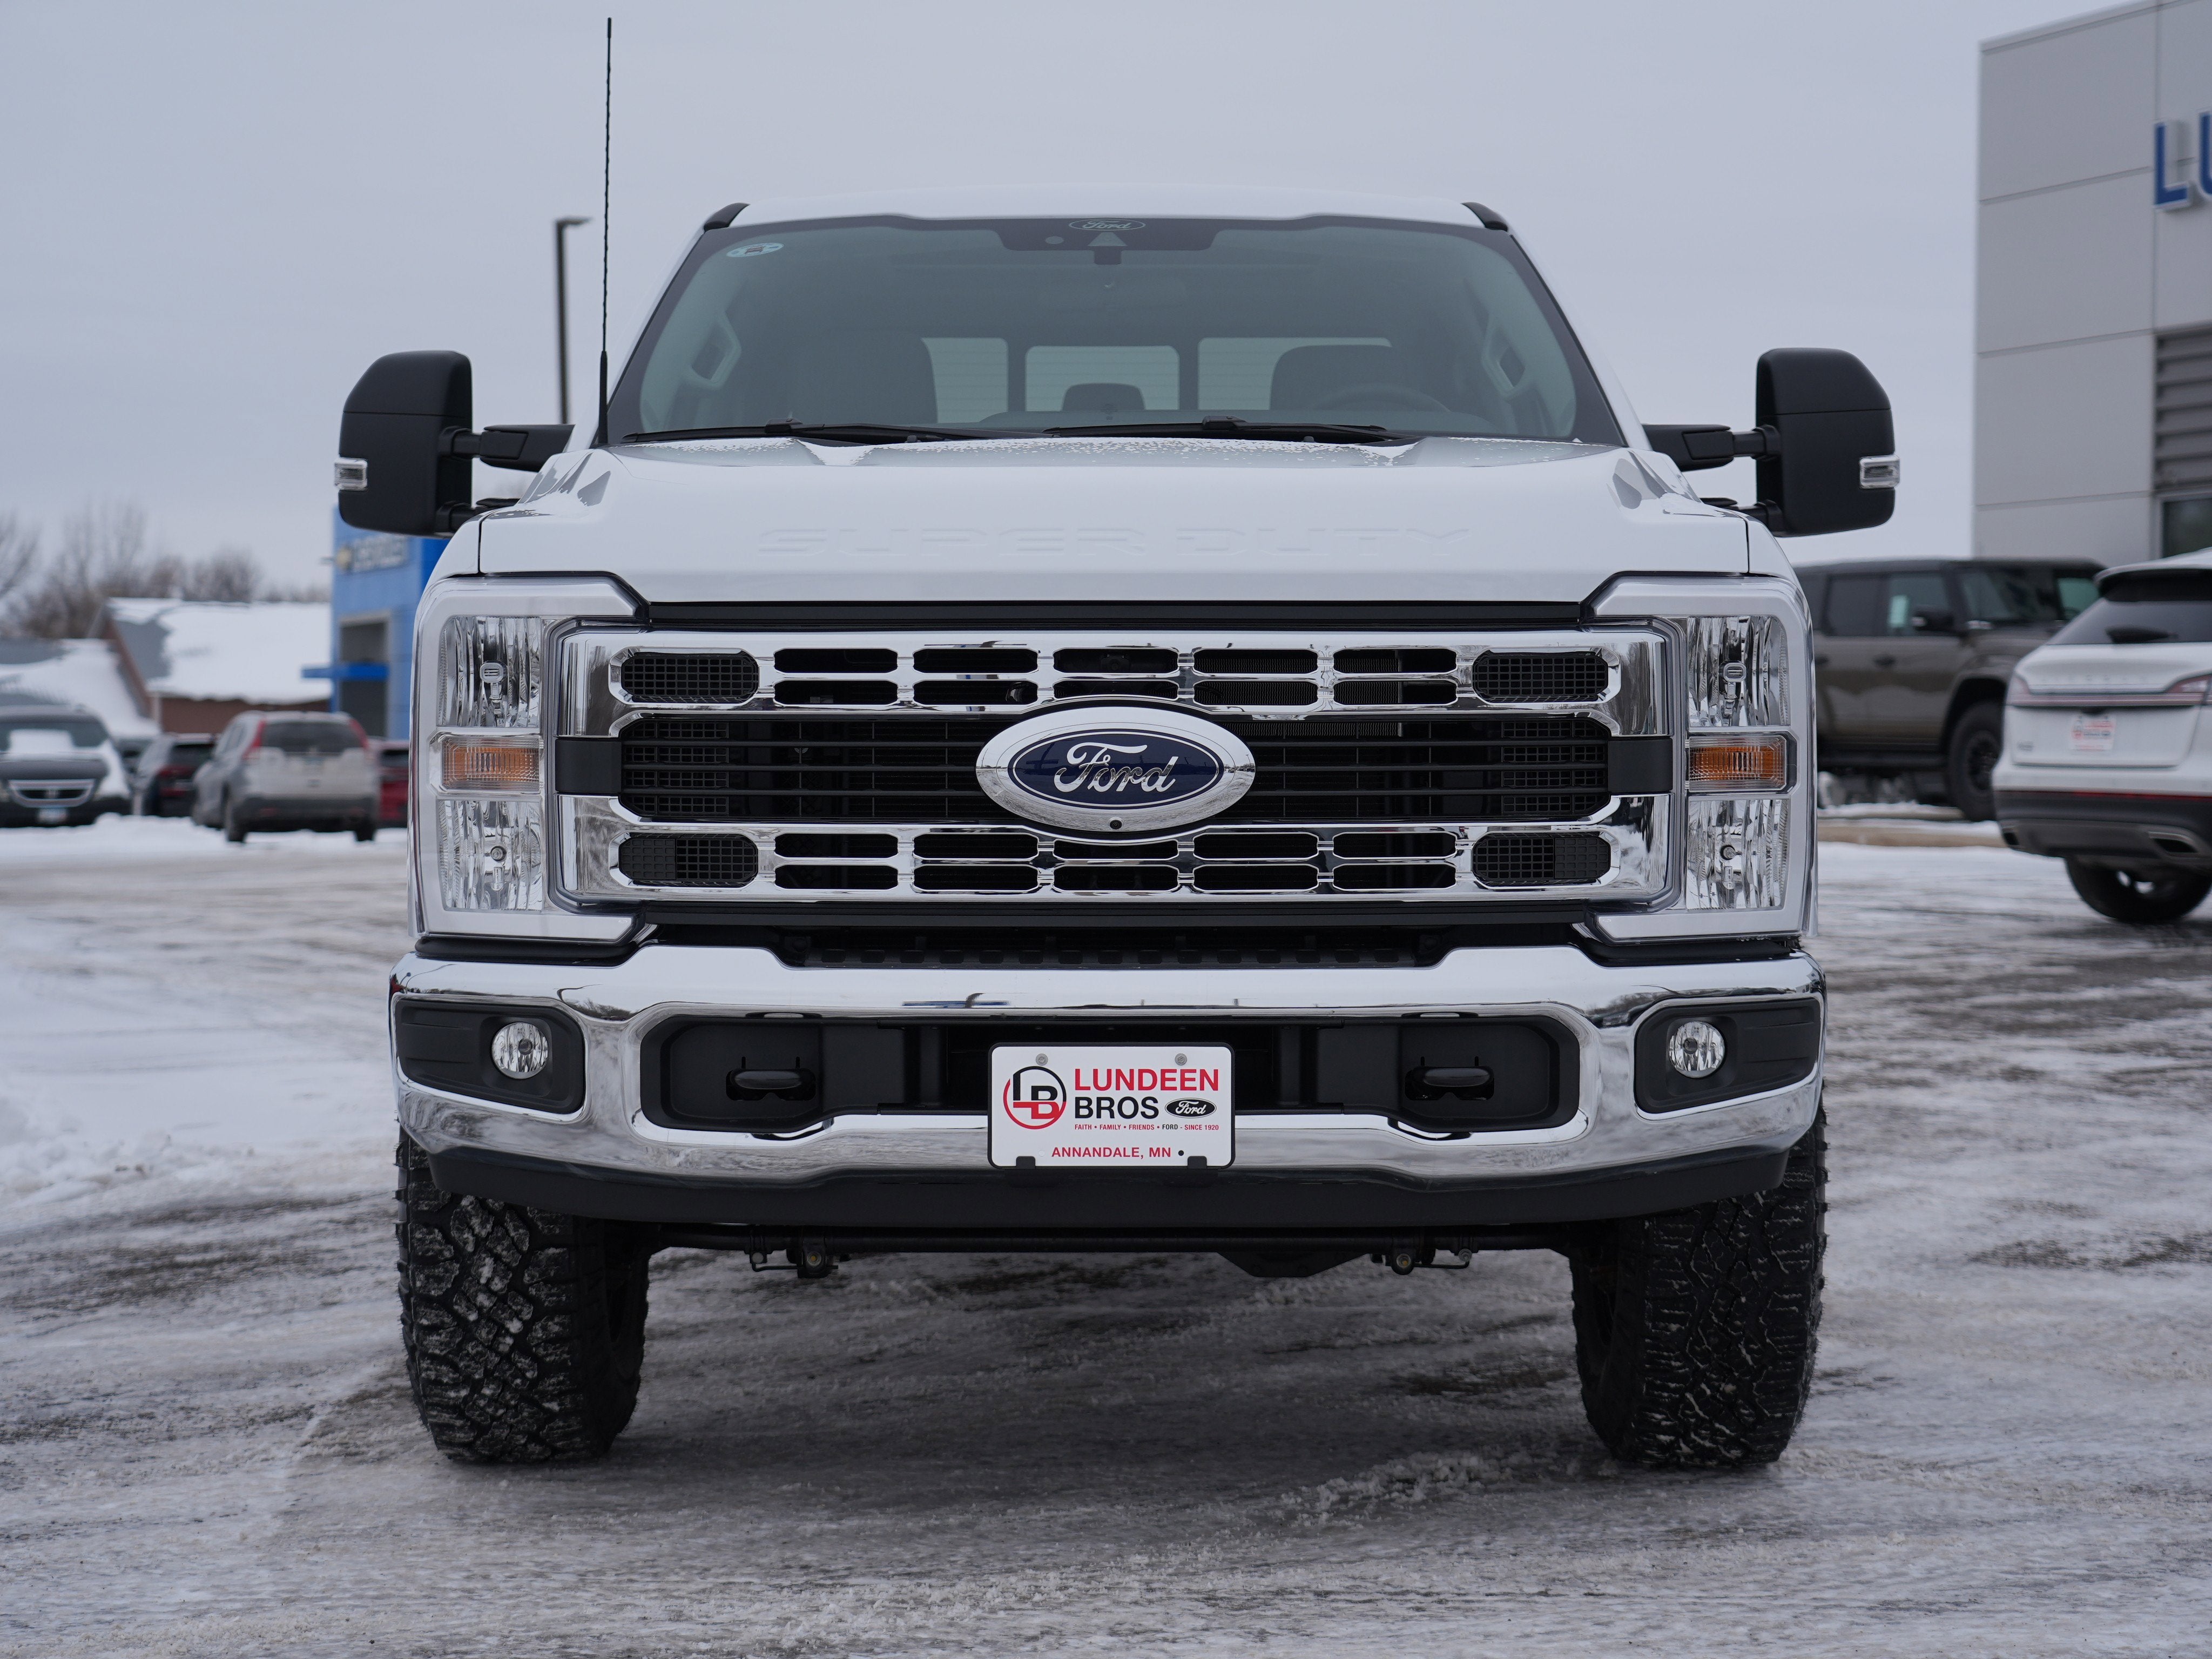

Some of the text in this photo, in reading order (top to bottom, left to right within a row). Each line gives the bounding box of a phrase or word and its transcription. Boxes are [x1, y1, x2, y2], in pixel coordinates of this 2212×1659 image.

[1083, 220, 1132, 228] Ford
[758, 528, 1472, 556] SUPER DUTY
[1054, 741, 1179, 792] Ford
[1075, 1068, 1219, 1091] LUNDEEN
[1075, 1096, 1206, 1120] BROS Ford
[1051, 1147, 1171, 1159] ANNANDALE, MN
